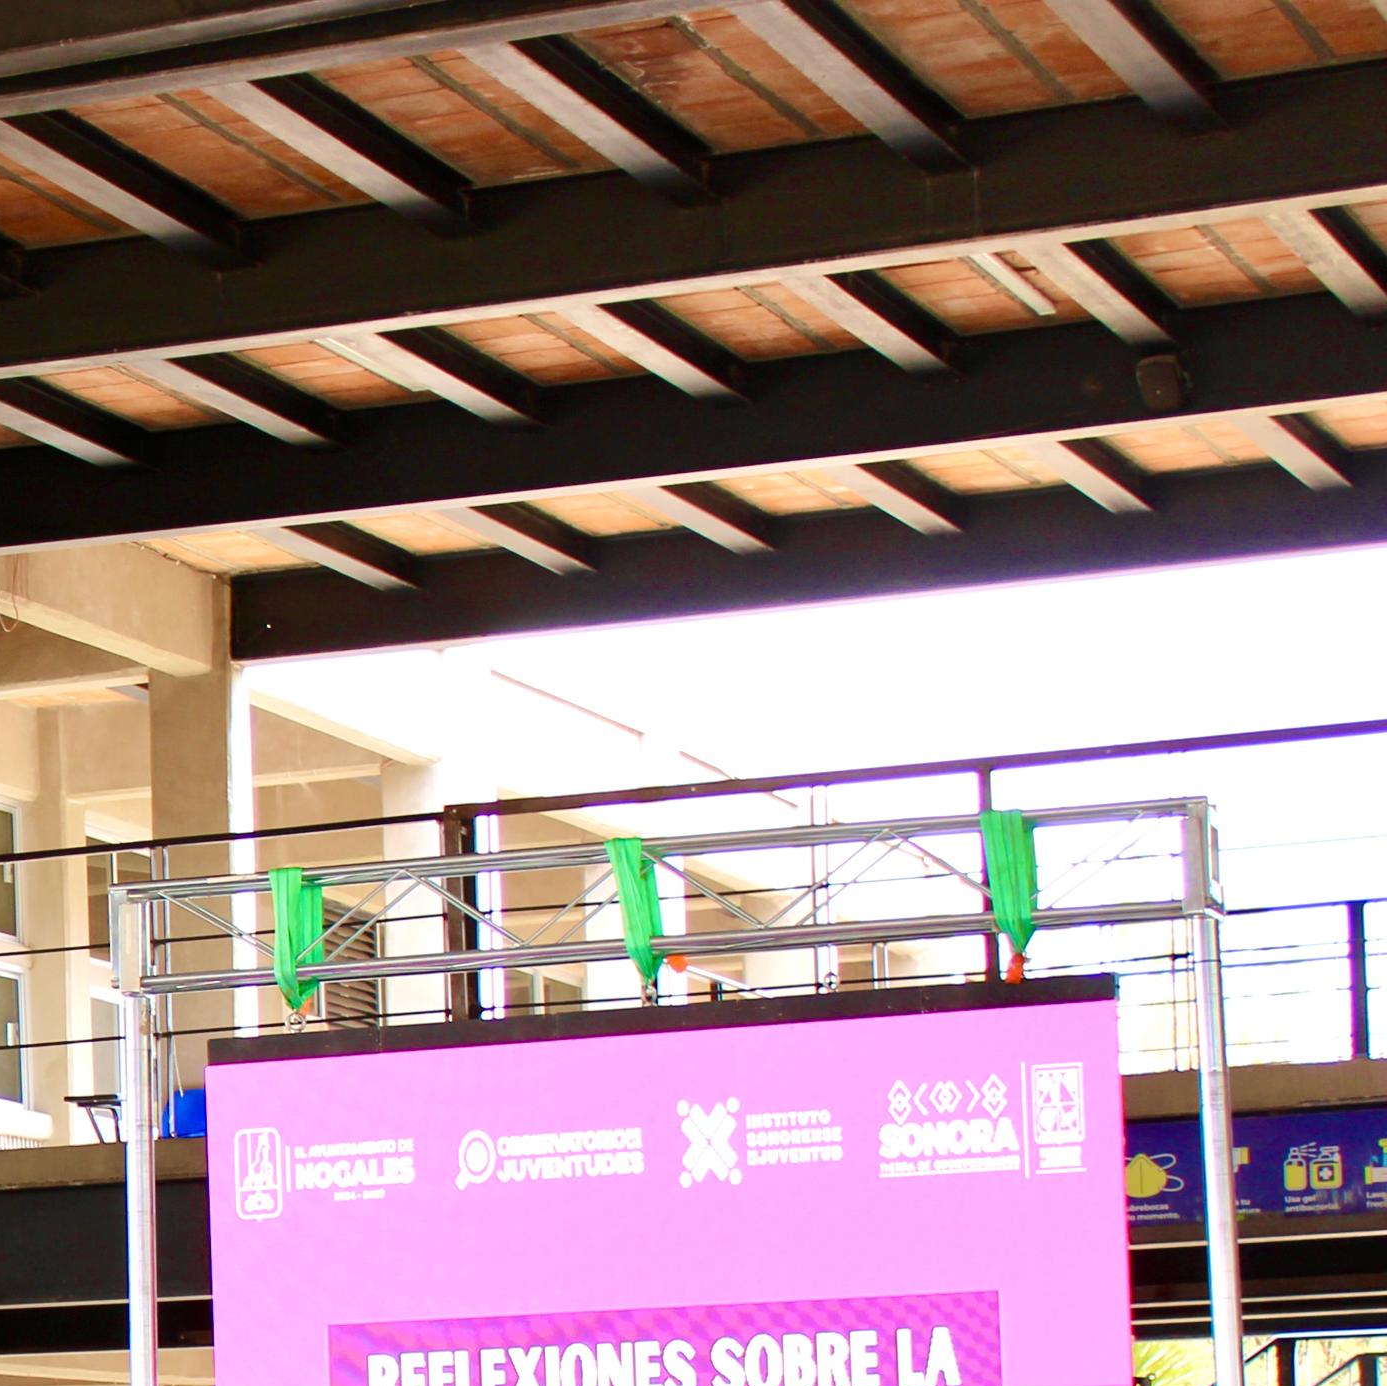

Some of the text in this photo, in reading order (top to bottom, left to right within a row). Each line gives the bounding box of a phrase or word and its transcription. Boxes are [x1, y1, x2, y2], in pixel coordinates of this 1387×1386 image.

[746, 1109, 831, 1130] INSTITUTO
[746, 1126, 843, 1148] SONORENSE
[879, 1117, 1020, 1159] SONORA
[294, 1156, 415, 1190] NOGALES
[497, 1150, 645, 1183] JUVENTUDES
